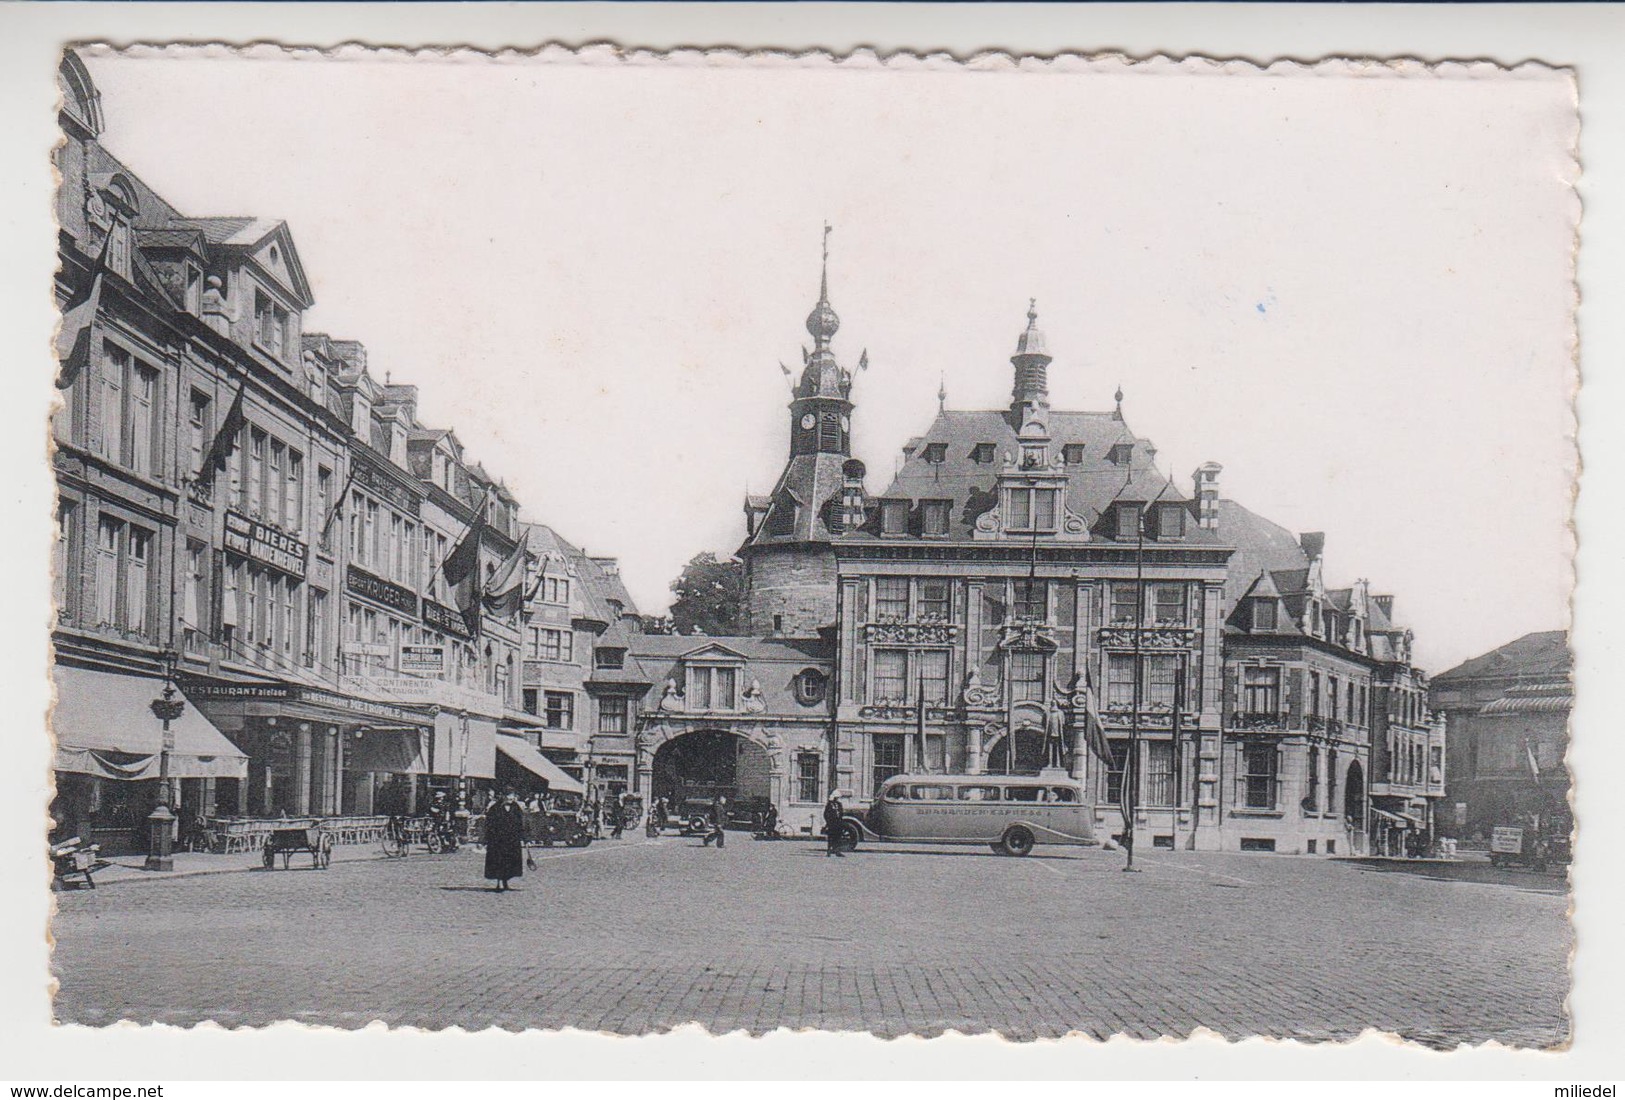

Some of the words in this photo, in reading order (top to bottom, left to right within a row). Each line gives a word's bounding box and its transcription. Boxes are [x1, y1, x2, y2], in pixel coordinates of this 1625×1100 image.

[255, 526, 304, 557] BIERES
[367, 579, 400, 605] KRUGER
[183, 686, 257, 697] RESTAURANT
[377, 678, 434, 688] CONTINENTAL
[350, 699, 401, 718] METROPOLE
